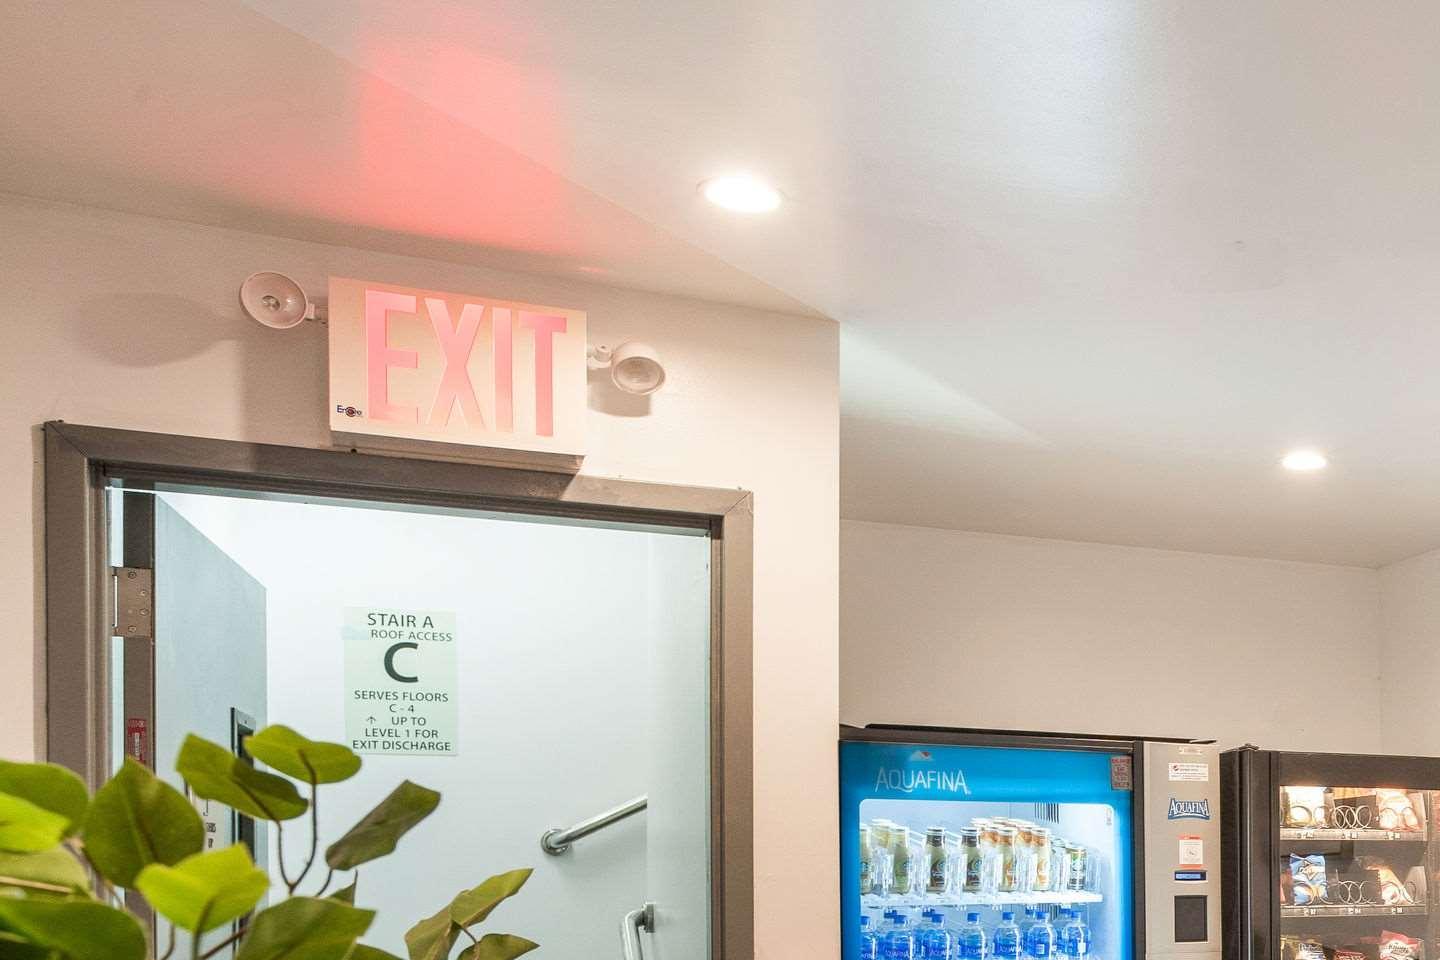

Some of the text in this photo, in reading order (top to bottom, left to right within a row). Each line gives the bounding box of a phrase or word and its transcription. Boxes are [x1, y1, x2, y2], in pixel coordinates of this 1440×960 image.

[365, 289, 568, 437] EXIT
[367, 613, 434, 628] STAIR A
[371, 629, 453, 642] ROOF ACCESS
[383, 641, 419, 683] C
[354, 690, 449, 702] SERVES FLOORS
[389, 703, 397, 713] C
[407, 704, 415, 713] 4
[391, 716, 427, 726] UP TO
[365, 728, 439, 739] LEVEL 1 FOR
[352, 740, 451, 752] EXIT DISCHARGE
[874, 767, 969, 795] AQUAFINA
[1168, 798, 1210, 817] AQUAFINA
